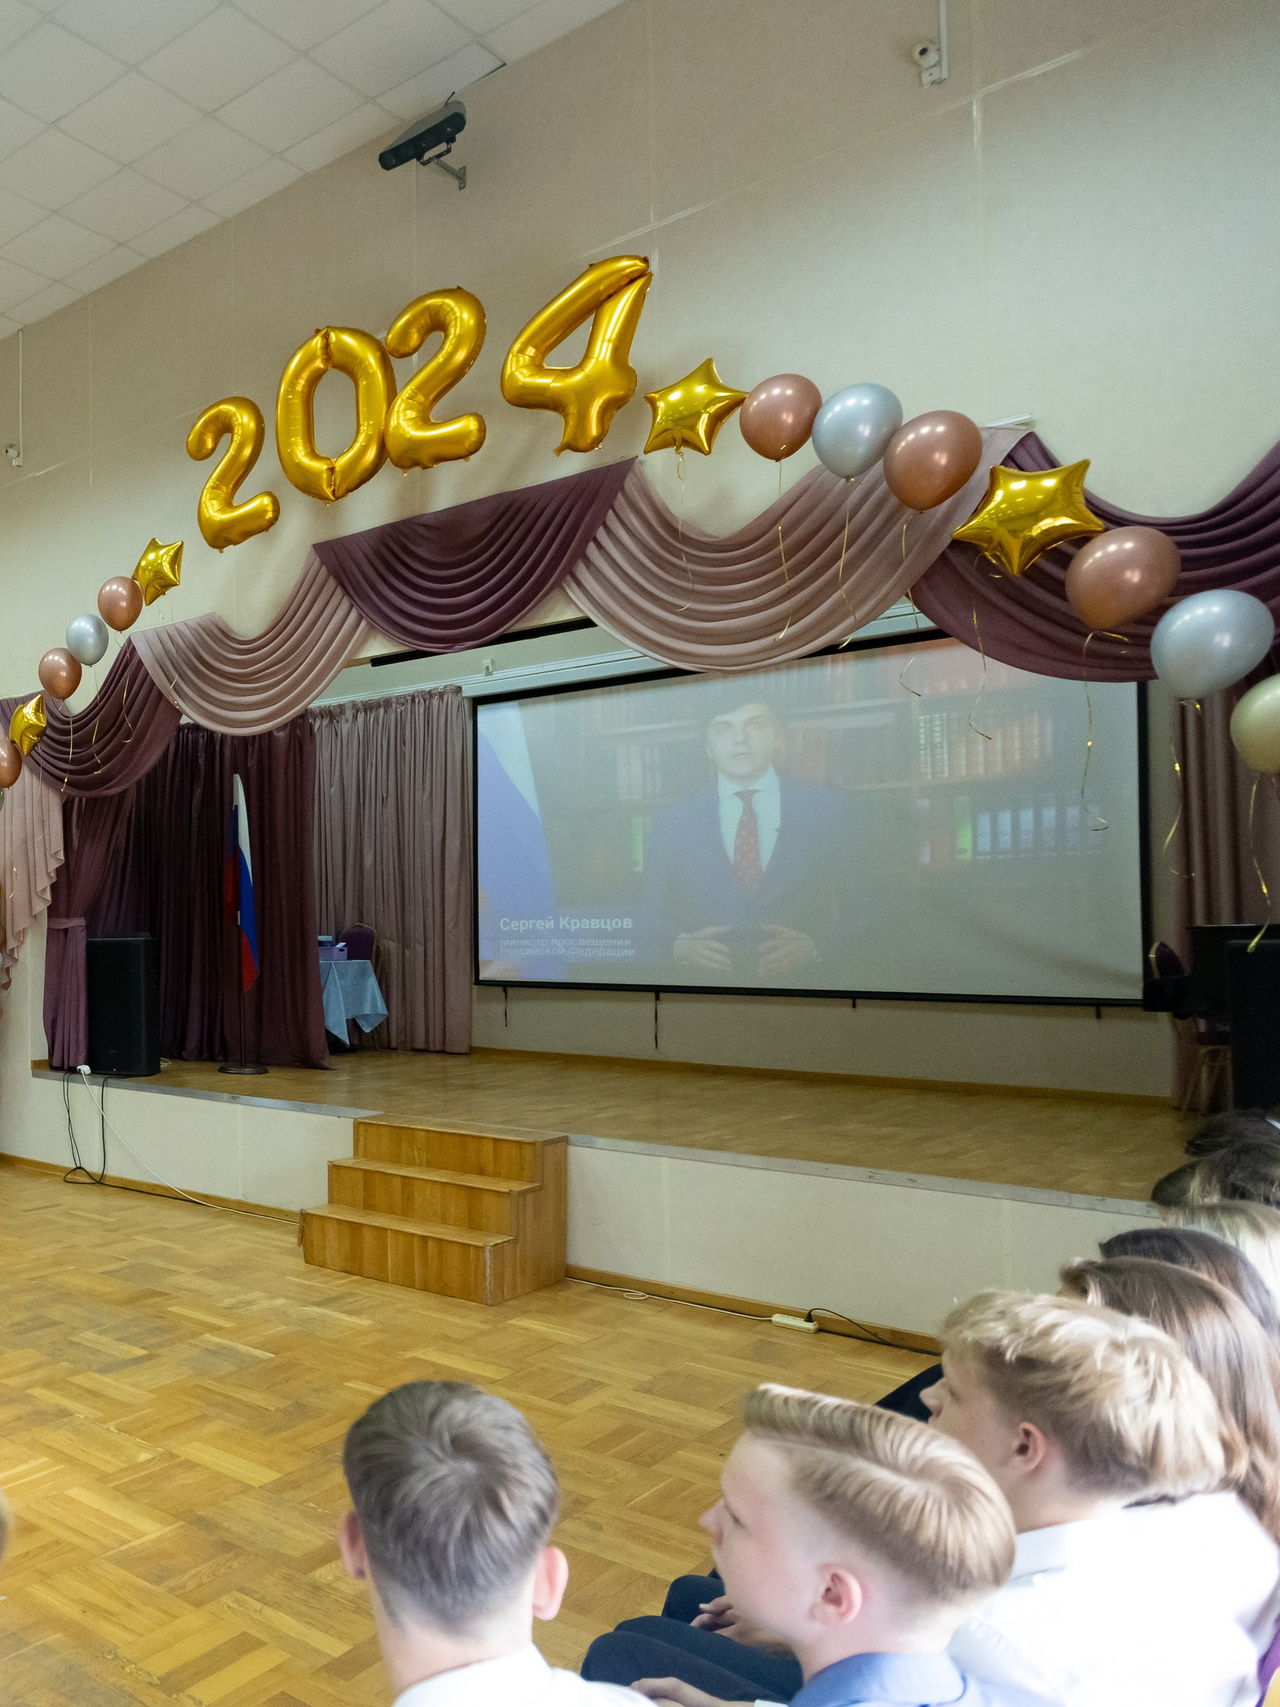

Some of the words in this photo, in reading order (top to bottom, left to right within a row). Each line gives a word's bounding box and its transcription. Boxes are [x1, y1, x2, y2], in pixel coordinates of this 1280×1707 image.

[186, 255, 652, 553] 2024
[499, 915, 555, 933] Сергей
[559, 915, 634, 932] Кравцов
[568, 946, 636, 958] Федерации
